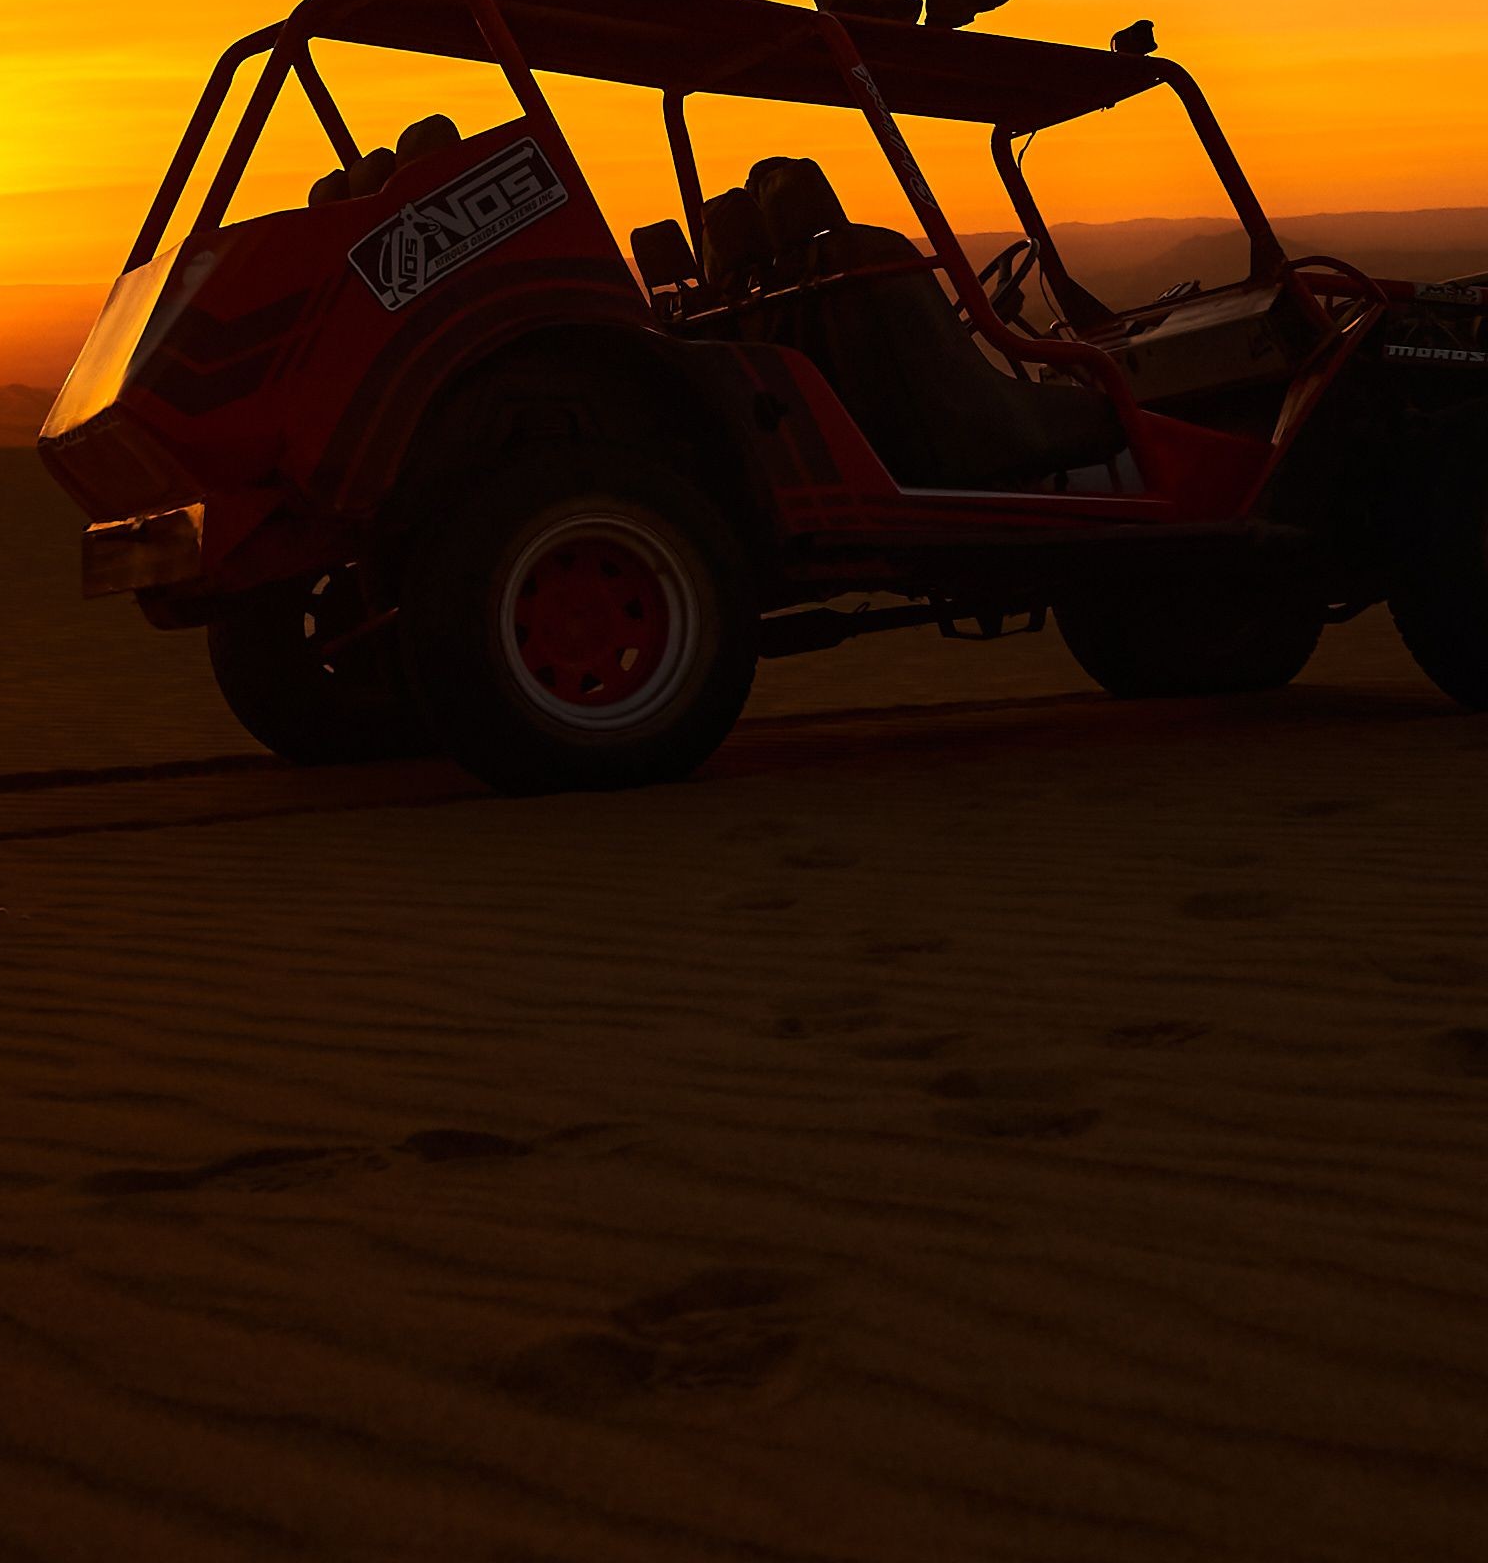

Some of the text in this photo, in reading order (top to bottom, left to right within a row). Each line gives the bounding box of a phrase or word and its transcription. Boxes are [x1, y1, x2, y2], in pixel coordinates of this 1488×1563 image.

[420, 159, 544, 251] NOS
[470, 225, 498, 247] OXIDE
[498, 200, 538, 230] SYSTEMS
[538, 190, 554, 207] INC
[398, 238, 417, 295] NOS
